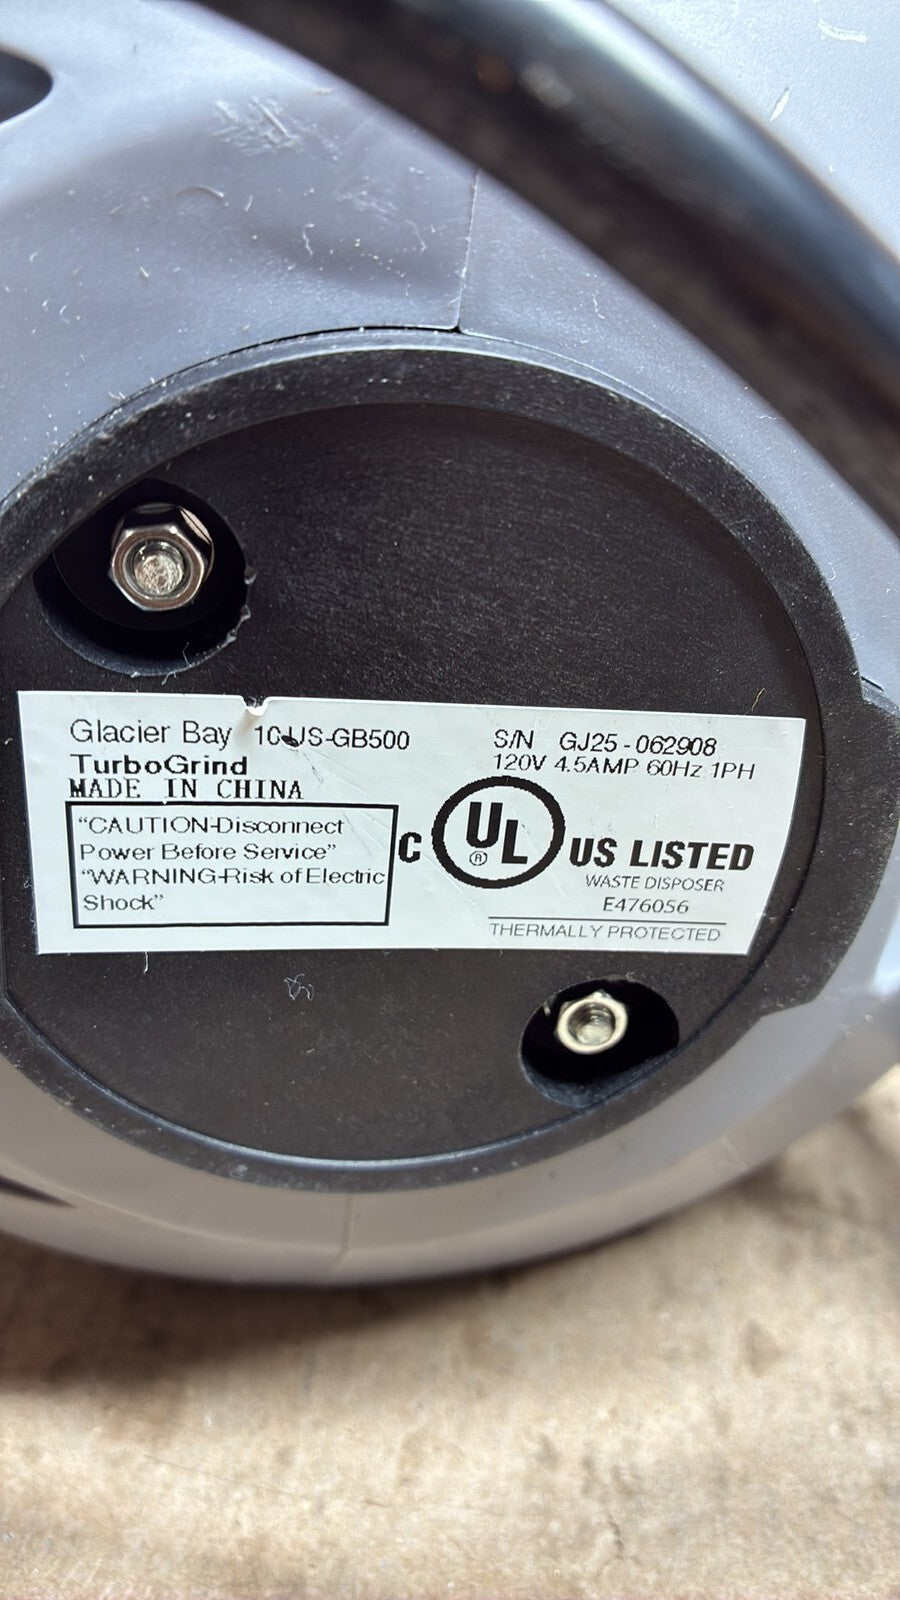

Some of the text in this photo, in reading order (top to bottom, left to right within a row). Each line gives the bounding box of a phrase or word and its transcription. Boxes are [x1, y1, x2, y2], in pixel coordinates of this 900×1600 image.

[70, 718, 171, 745] Glacier
[182, 719, 233, 751] Bay
[494, 729, 534, 750] S/N
[70, 754, 248, 776] TurboGrind
[494, 753, 755, 780] 120V 4.5AMP 60Hz 1PH
[69, 778, 304, 800] MADE IN CHINA
[466, 801, 528, 865] UL
[569, 837, 618, 868] US
[629, 840, 754, 871] LISTED
[80, 843, 153, 861] Power
[162, 844, 237, 861] Before
[280, 868, 304, 884] of
[306, 868, 386, 885] Electric
[585, 874, 725, 892] WASTE DISPOSER
[602, 896, 690, 914] E476056
[489, 922, 721, 942] THERMALLY PROTECTED
